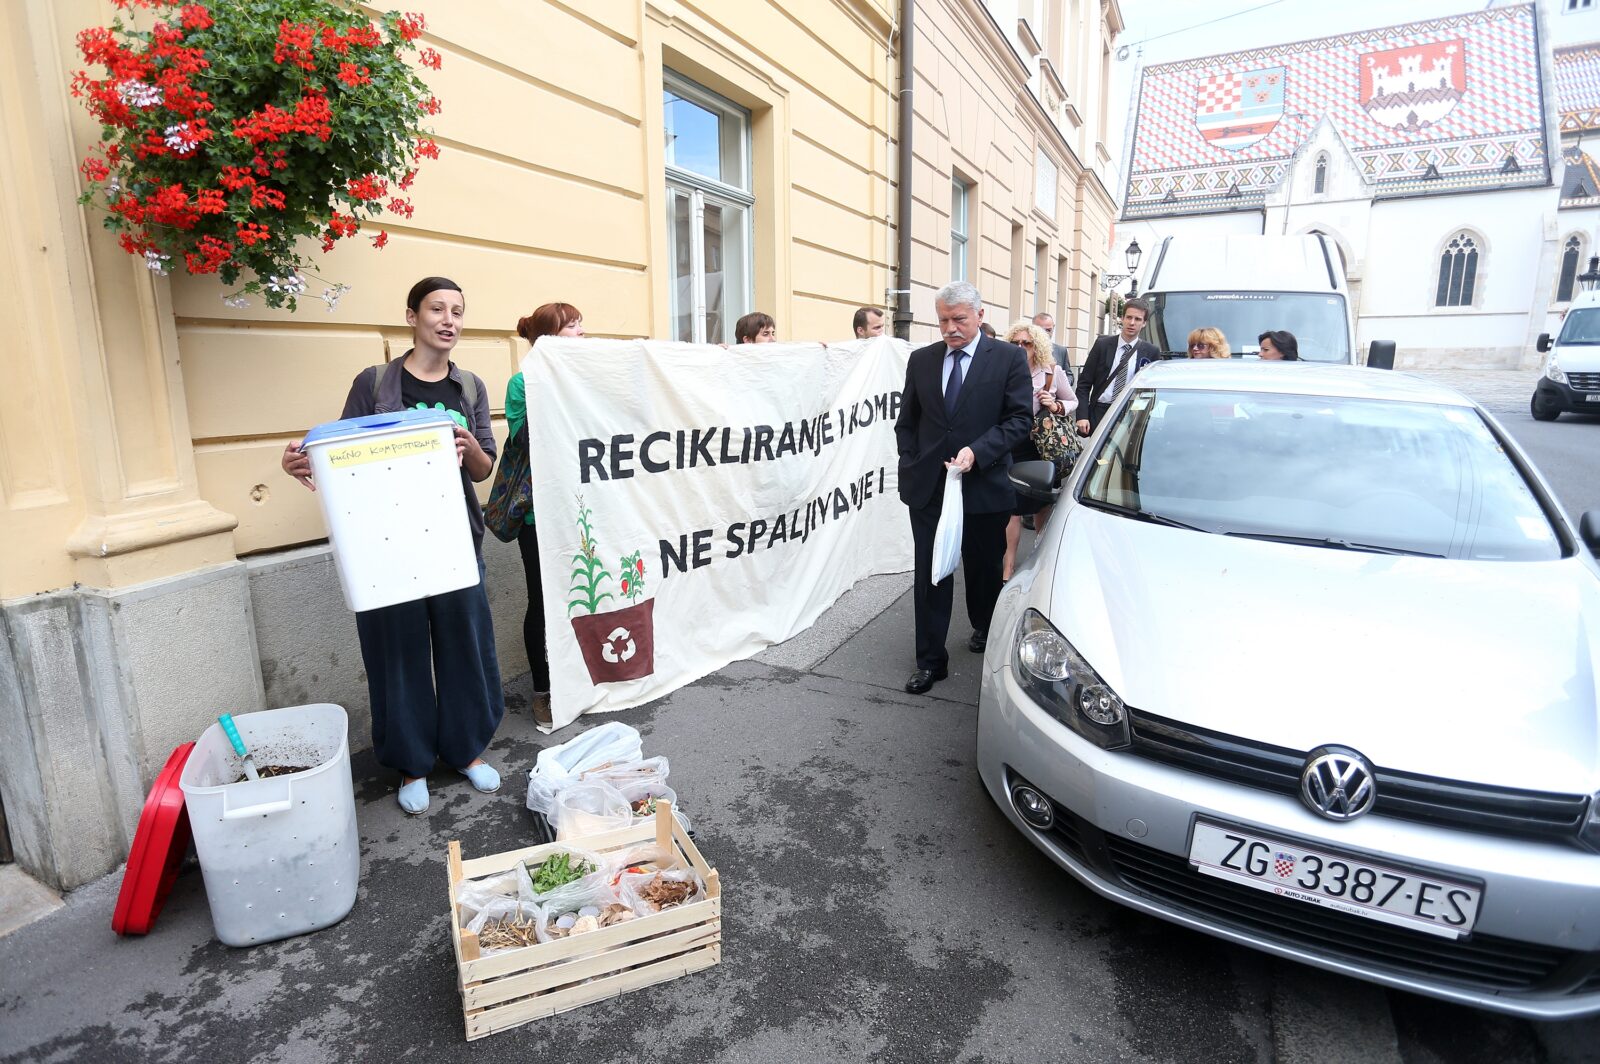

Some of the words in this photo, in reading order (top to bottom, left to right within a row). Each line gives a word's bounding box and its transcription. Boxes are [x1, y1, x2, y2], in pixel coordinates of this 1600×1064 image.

[369, 439, 440, 455] KOMPOSTIRANJE
[578, 413, 834, 483] RECIKLIRANJE
[838, 408, 846, 439] I
[659, 529, 713, 578] NE
[726, 470, 874, 558] SPALJIVANJE
[1220, 834, 1270, 876] ZG
[1284, 890, 1300, 899] AUTO
[1300, 894, 1321, 904] ZUBAK
